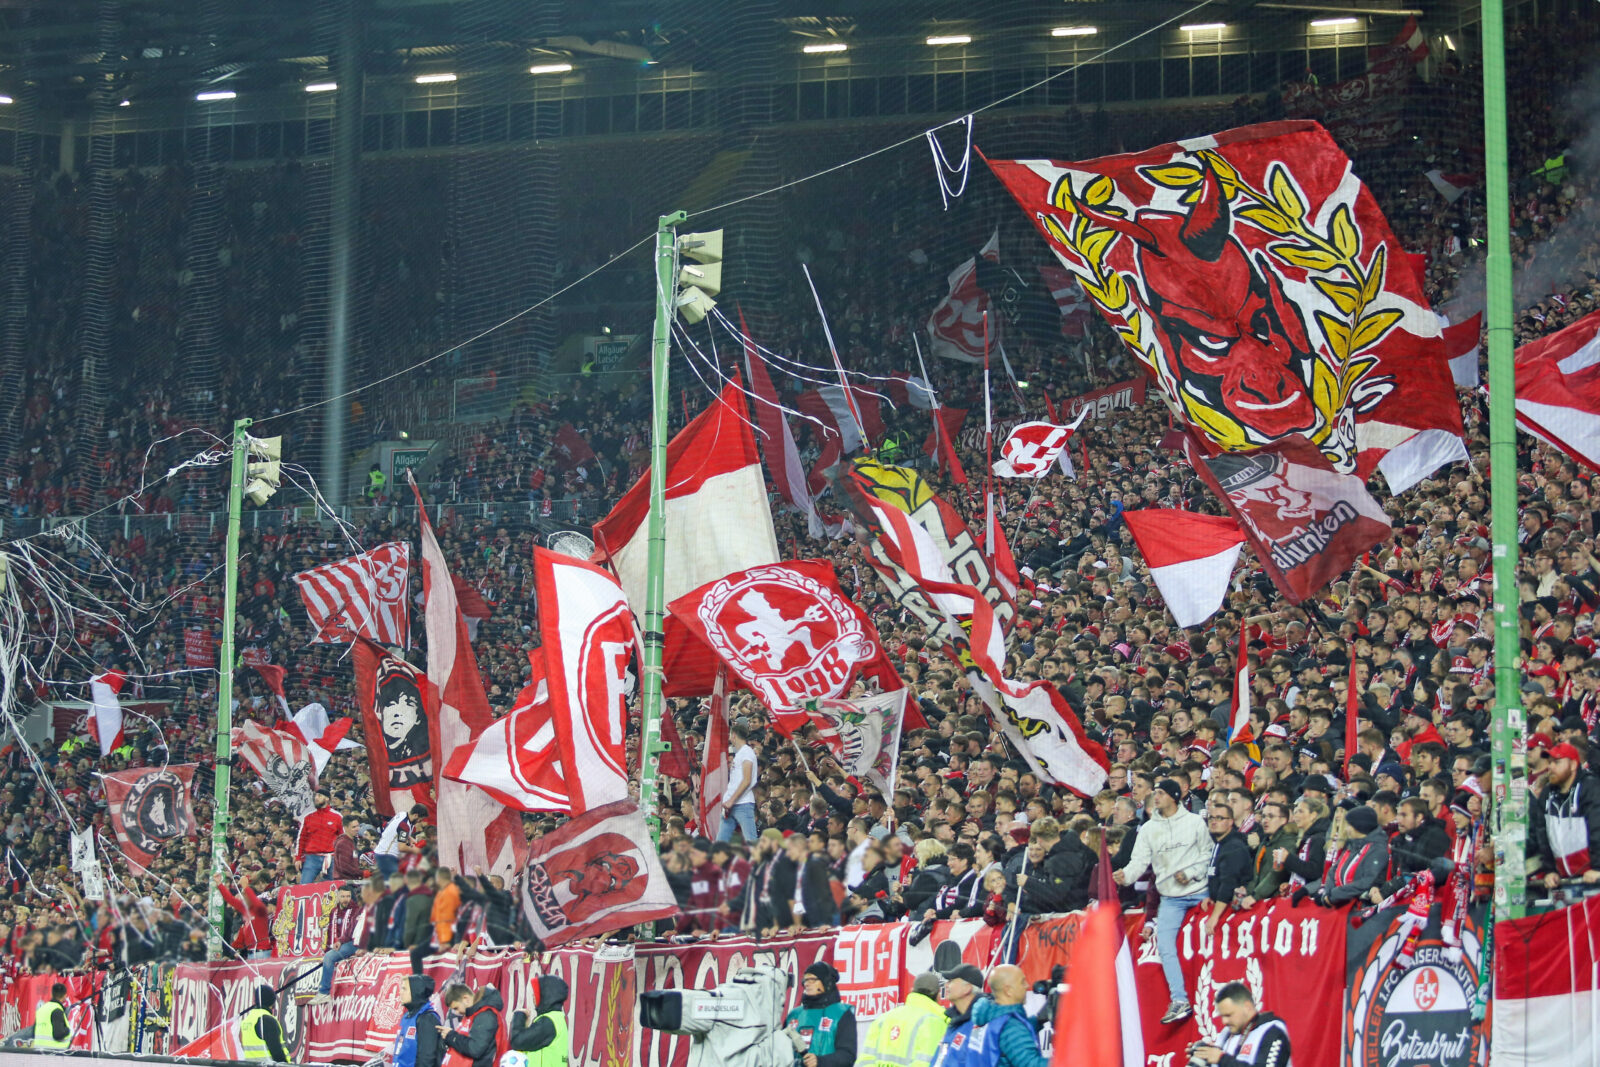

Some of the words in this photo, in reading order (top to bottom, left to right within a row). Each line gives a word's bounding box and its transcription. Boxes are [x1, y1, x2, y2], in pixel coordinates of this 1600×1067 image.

[765, 646, 850, 708] 1998
[704, 1004, 739, 1012] BUNDESLIGA
[1381, 1018, 1470, 1067] Betzebrut
